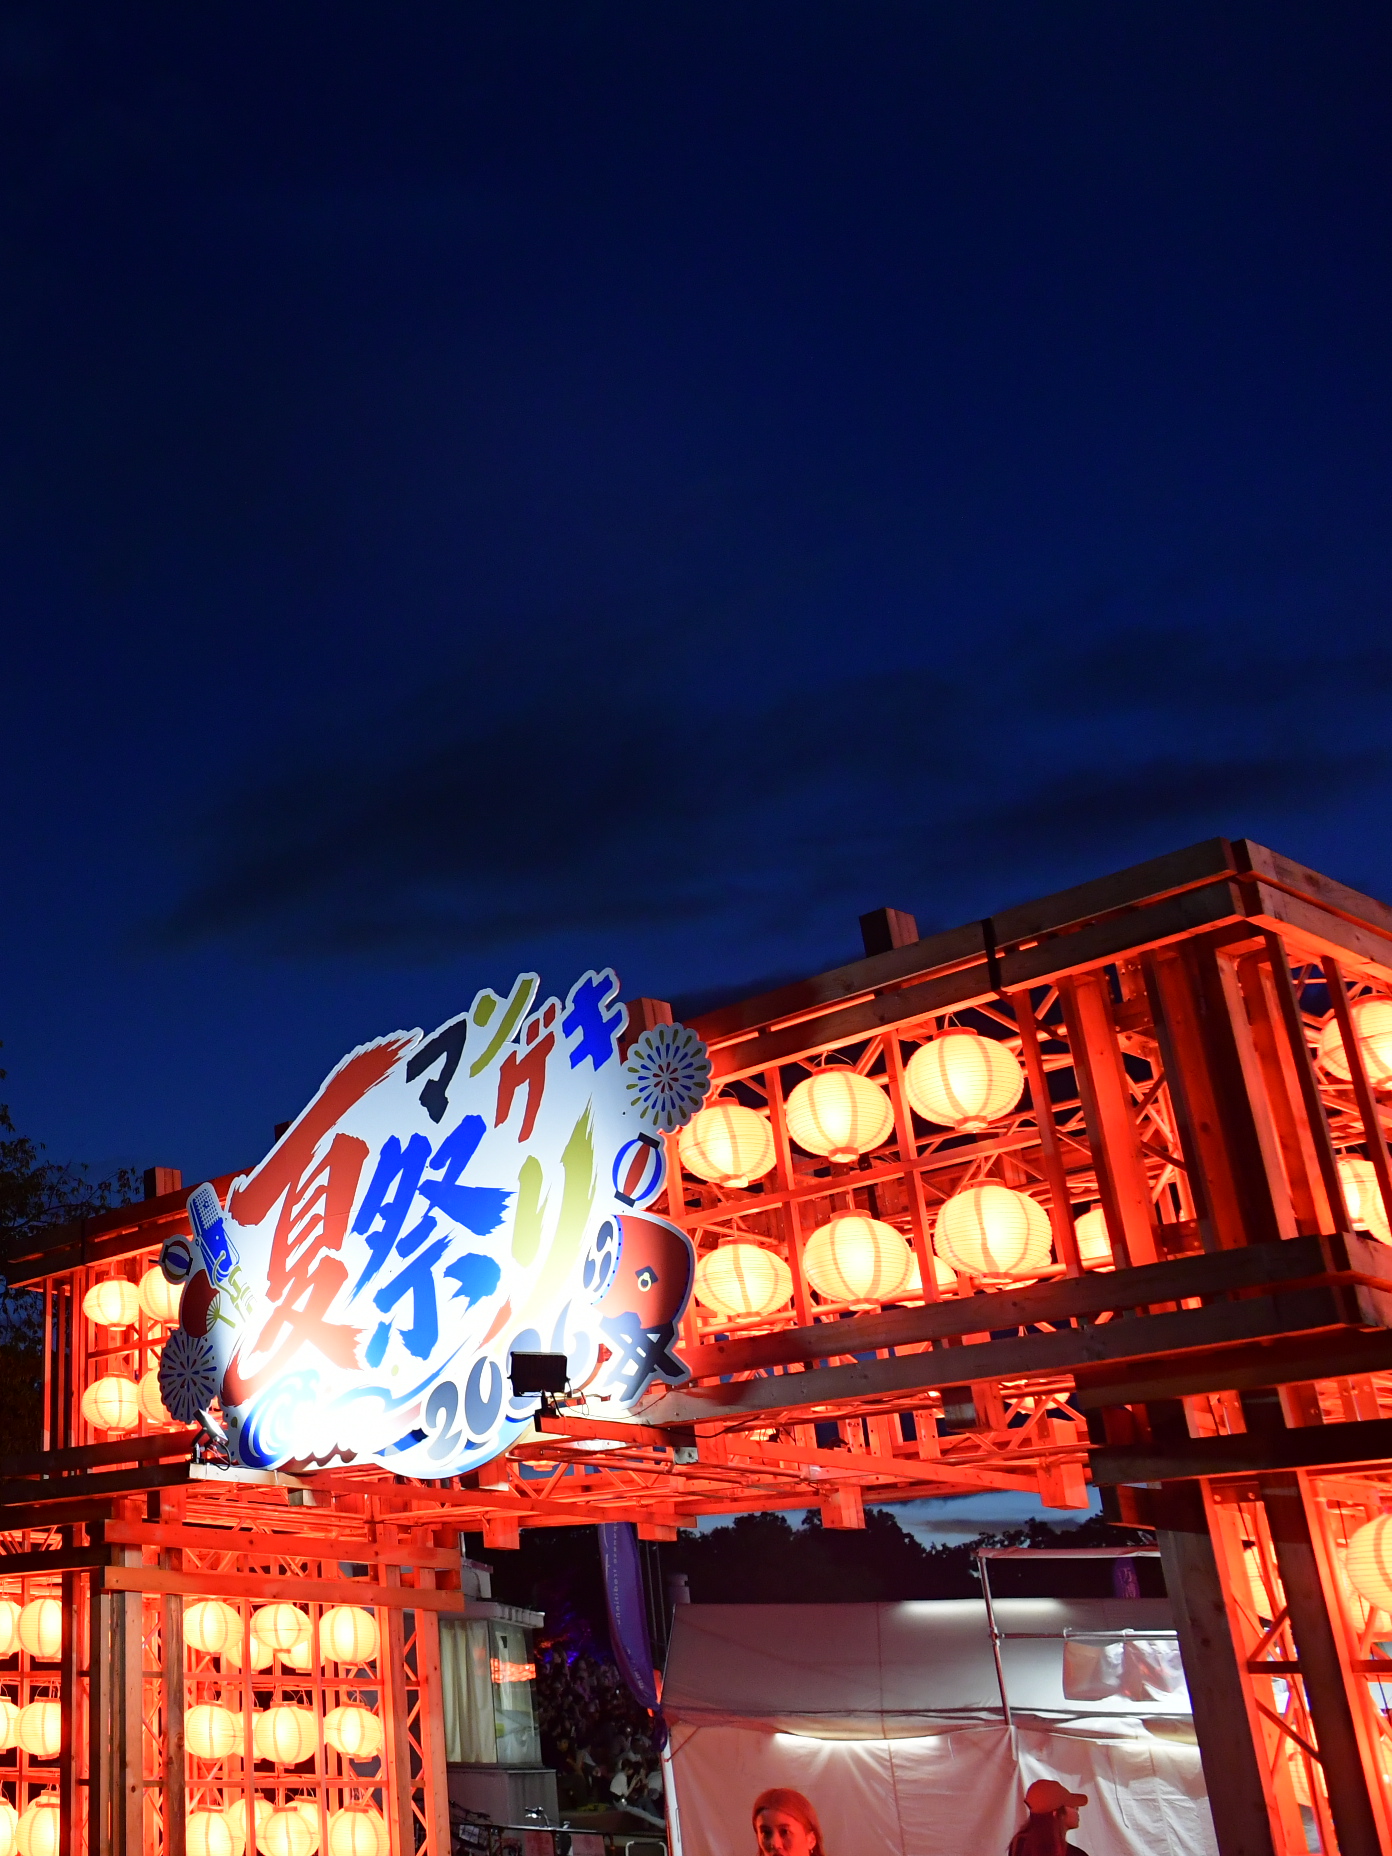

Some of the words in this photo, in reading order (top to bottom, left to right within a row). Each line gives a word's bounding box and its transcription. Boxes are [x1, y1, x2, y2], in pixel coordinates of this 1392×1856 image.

[406, 975, 622, 1142] マンゲキ
[228, 1038, 599, 1372] 夏祭り
